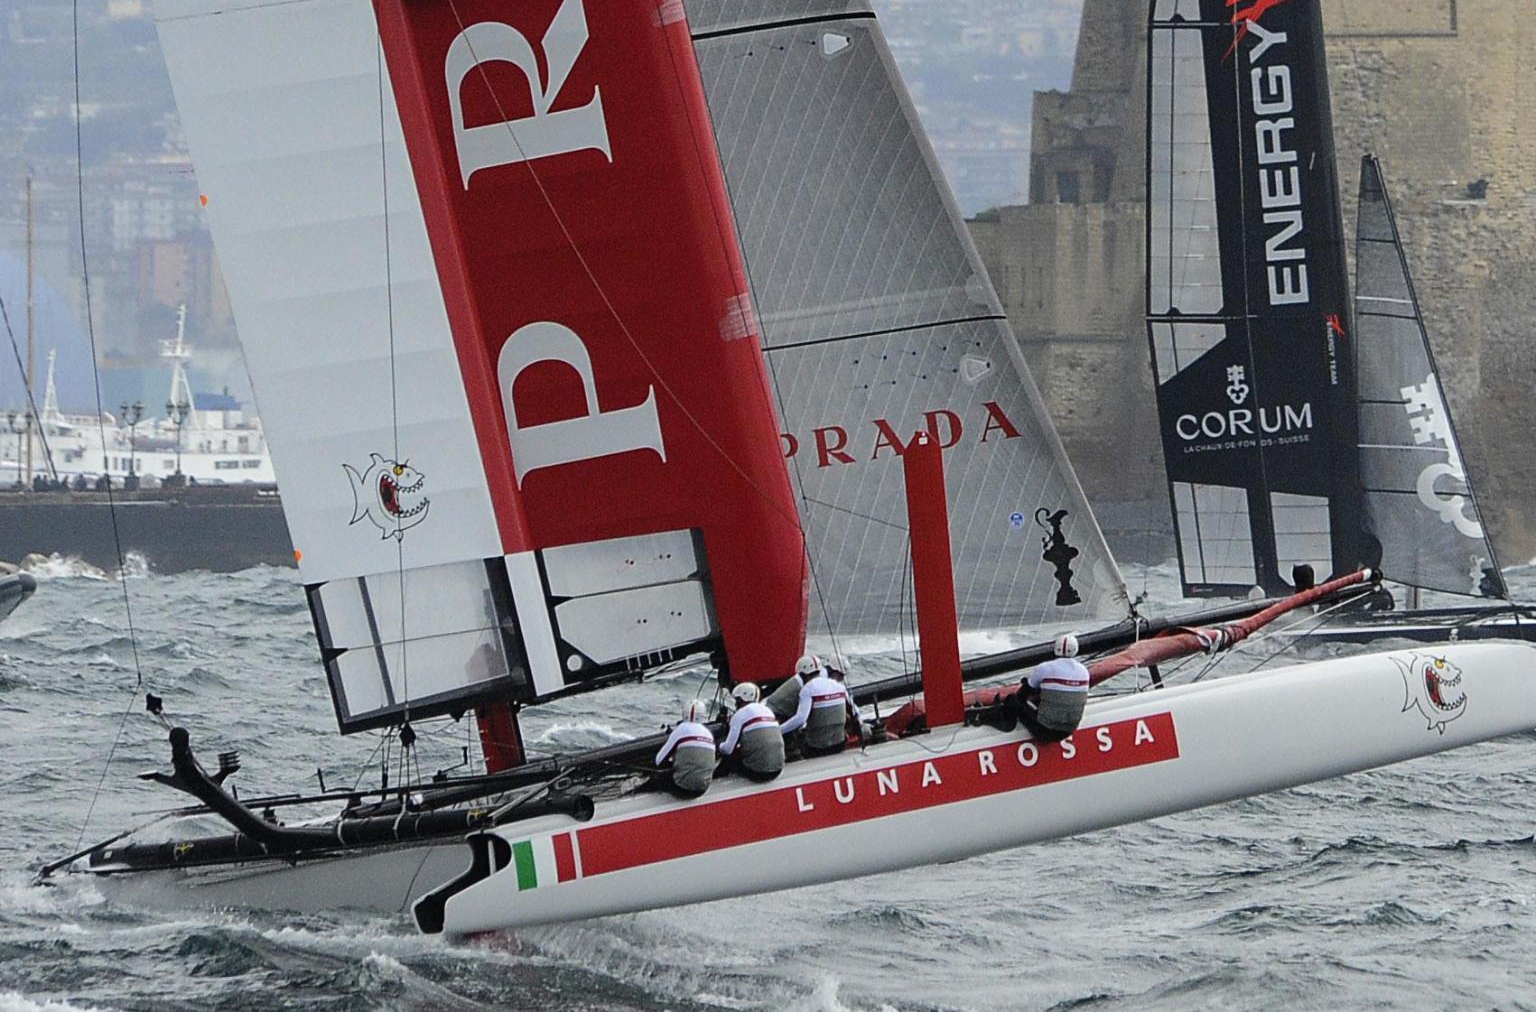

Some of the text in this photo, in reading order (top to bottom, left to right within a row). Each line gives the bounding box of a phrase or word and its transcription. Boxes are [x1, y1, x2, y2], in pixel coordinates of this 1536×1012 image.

[1246, 19, 1310, 305] ENERGY
[1176, 402, 1313, 440] CORUM
[796, 720, 1154, 813] LUNA ROSSA
